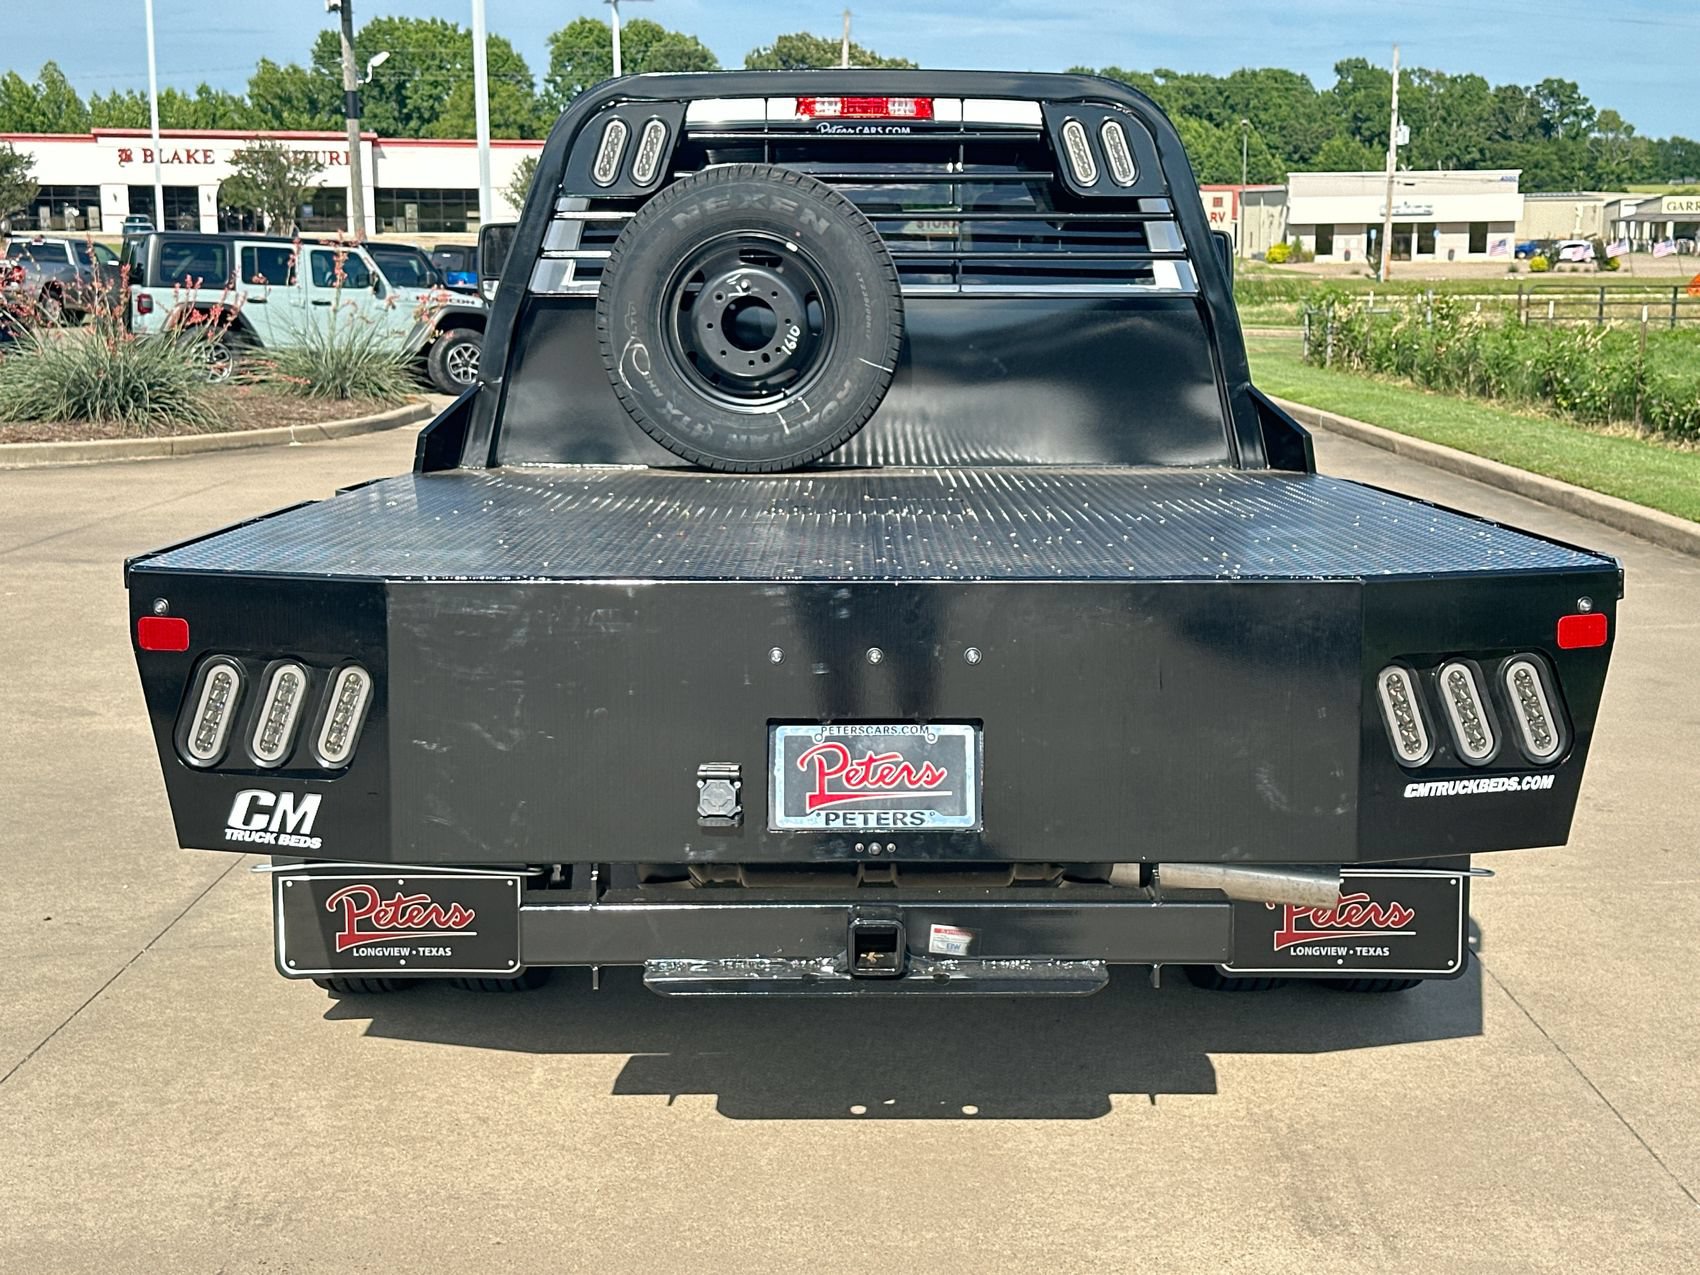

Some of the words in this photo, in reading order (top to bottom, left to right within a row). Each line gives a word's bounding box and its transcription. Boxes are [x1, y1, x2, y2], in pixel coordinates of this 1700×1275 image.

[142, 148, 215, 164] BLAKE
[672, 193, 831, 236] NEXEN
[1210, 211, 1226, 223] RV
[820, 725, 930, 736] PETERSCARS.COM
[797, 742, 952, 812] Peters
[1403, 774, 1555, 798] CMTRUCKBEDS.COM
[227, 788, 323, 835] CM
[825, 811, 927, 826] PETERS
[224, 828, 278, 844] TRUCK
[277, 833, 323, 849] BEDS
[326, 884, 477, 952] Peters
[353, 947, 411, 957] LONGVIEW
[418, 947, 452, 957] TEXAS
[1290, 946, 1348, 956] LONGVIEW
[1356, 947, 1390, 956] TEXAS
